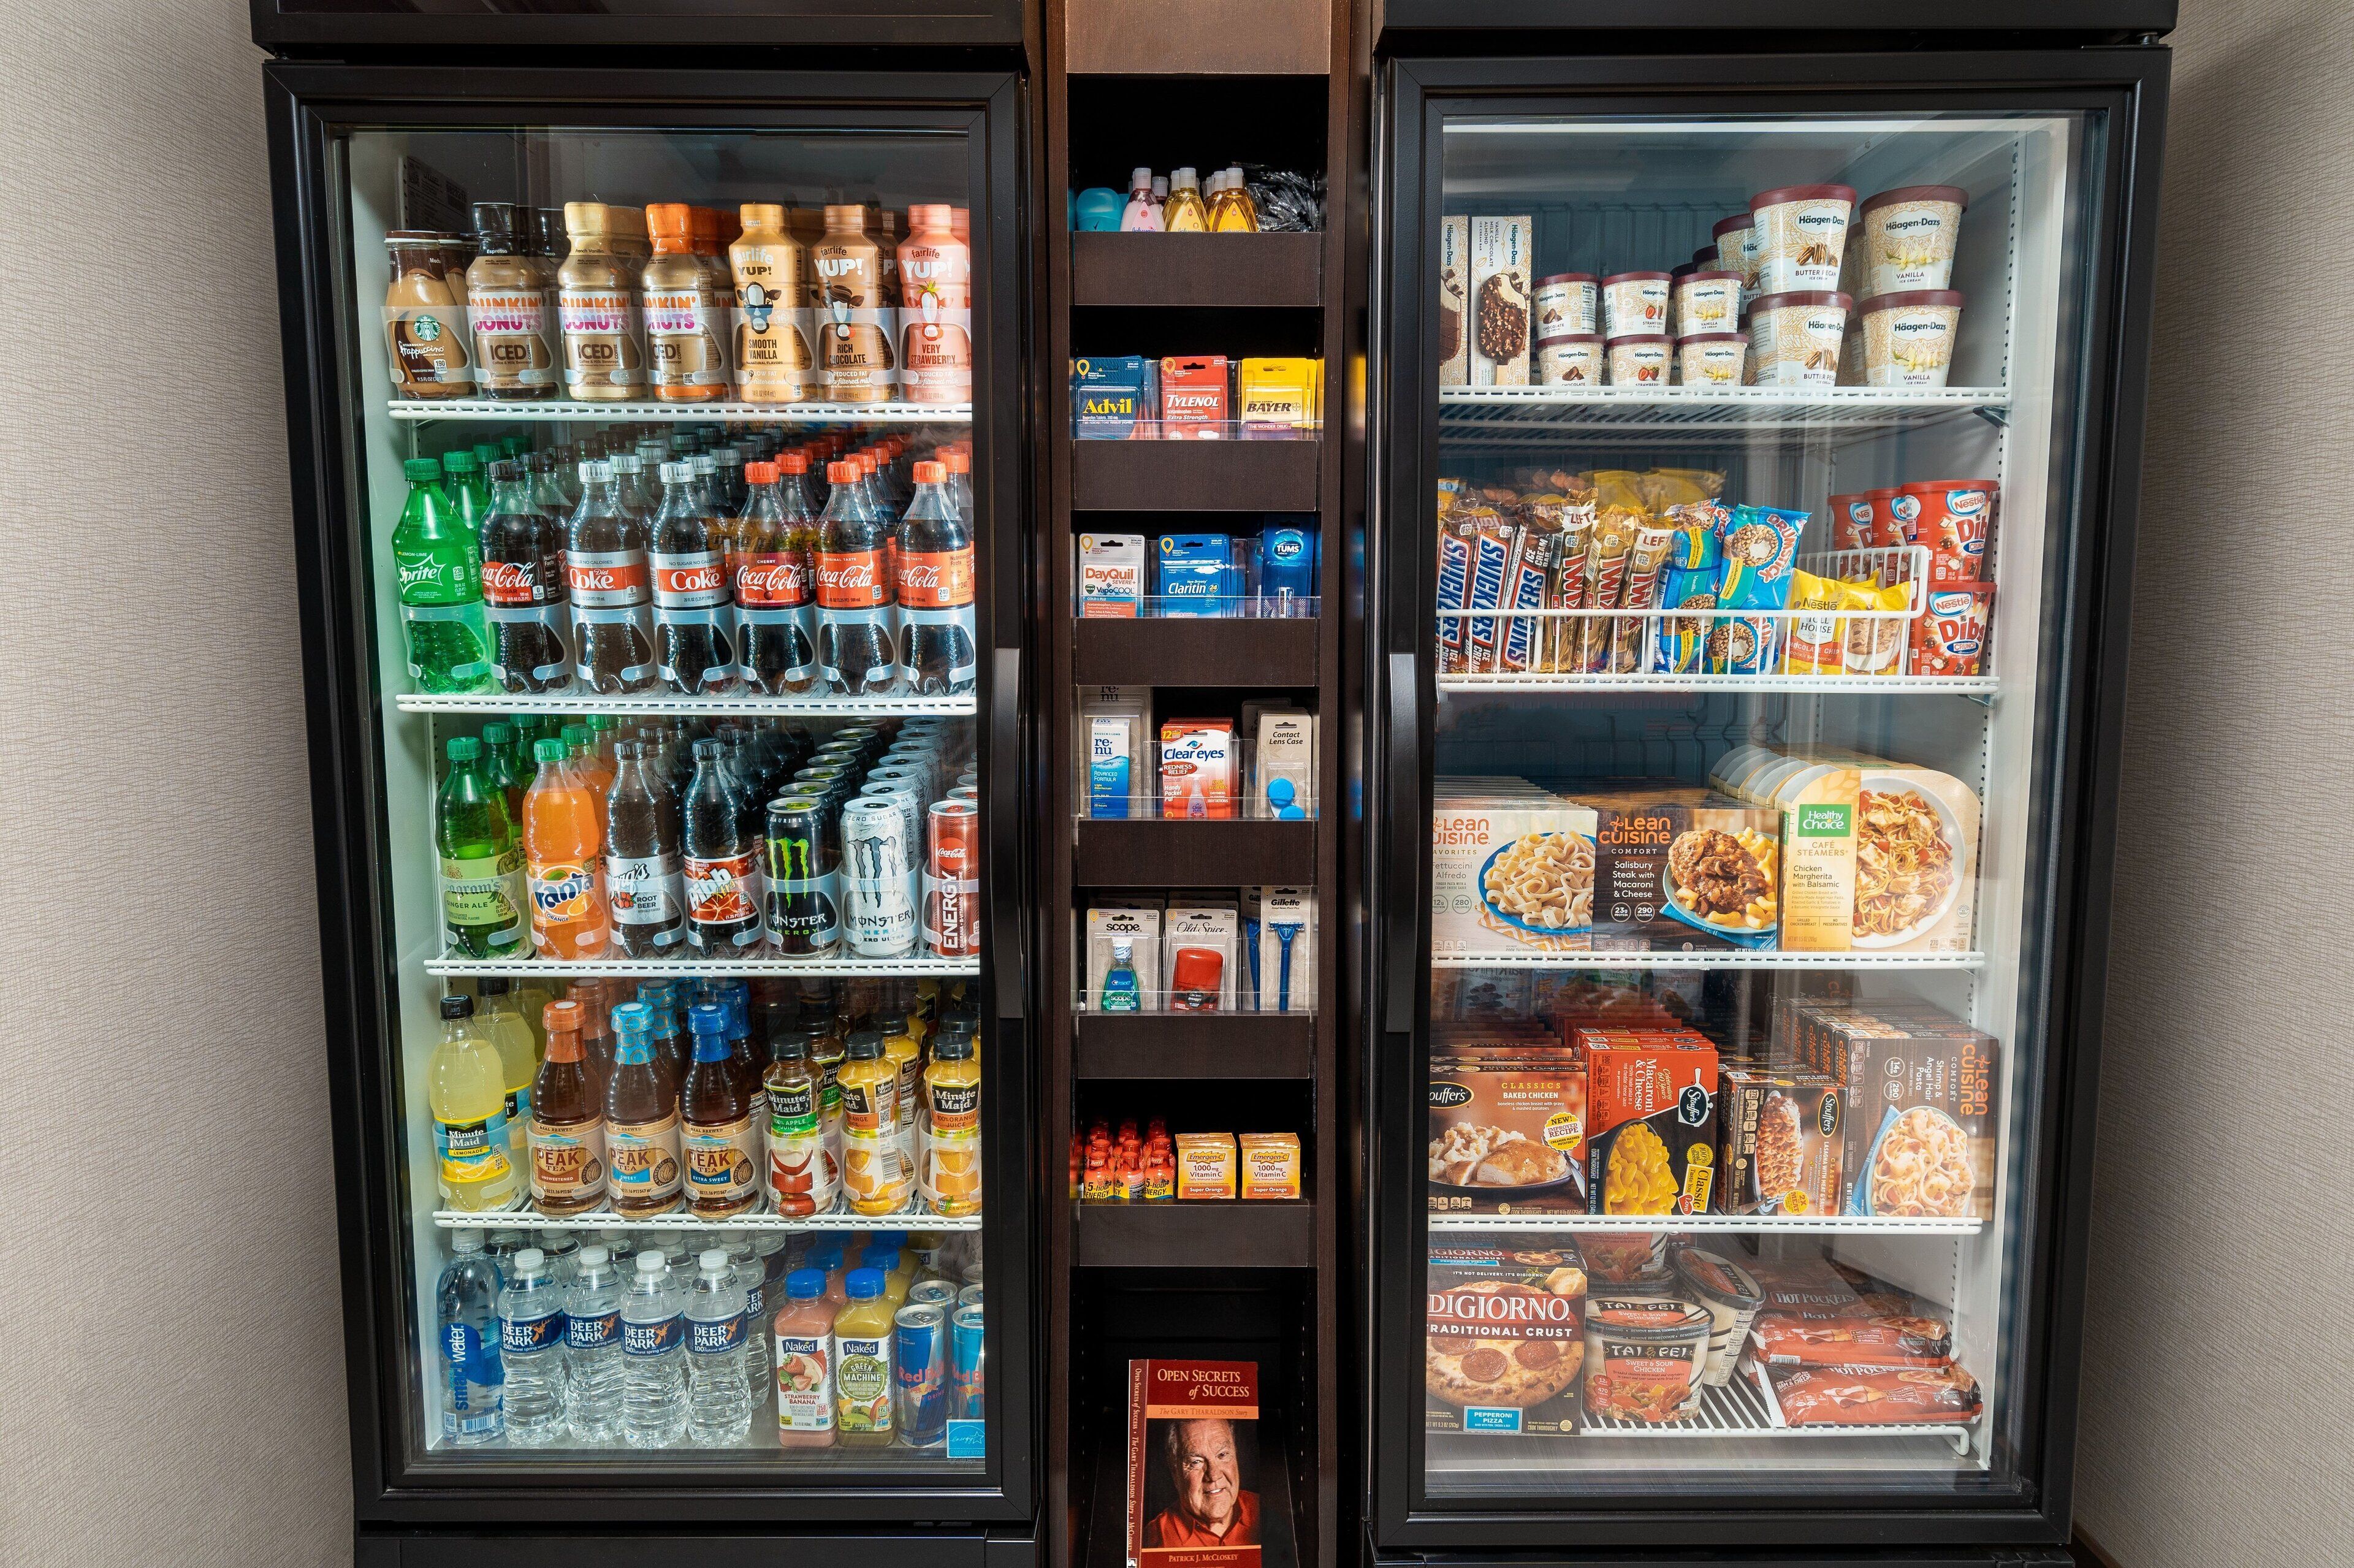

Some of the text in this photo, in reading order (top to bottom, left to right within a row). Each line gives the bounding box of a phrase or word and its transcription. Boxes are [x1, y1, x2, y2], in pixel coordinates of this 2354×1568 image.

[738, 267, 771, 275] YUP!
[814, 259, 864, 276] YUP!
[902, 259, 953, 278] YUP!
[748, 340, 777, 348] SMOOTH
[837, 344, 853, 353] RICH
[922, 344, 940, 354] VERY
[490, 344, 526, 360] ICED
[577, 344, 613, 359] ICED
[749, 350, 777, 359] VANILLA
[829, 354, 866, 364] CHOCOLATE
[911, 355, 955, 364] STRAWBERRY
[1083, 398, 1132, 414] Advil
[1167, 395, 1218, 408] TYLENOL
[1247, 403, 1291, 412] BAYER
[1758, 514, 1799, 584] DRUMSTICK
[399, 566, 437, 584] Sprite
[569, 568, 614, 589] Coke
[671, 571, 720, 591] Coke
[737, 563, 802, 591] Coca-Cola
[817, 564, 875, 588] Coca-Cola
[1086, 568, 1133, 582] DayQuil
[1168, 583, 1205, 594] Claritin
[1937, 596, 1970, 611] Nestlé
[1938, 617, 1984, 643] Dibs
[1165, 749, 1224, 761] Clear eyes
[1808, 811, 1843, 821] Healthy
[1803, 819, 1844, 829] Choice
[1615, 861, 1653, 870] Salisbury
[534, 872, 594, 912] Fanta
[943, 871, 957, 948] ENERGY
[546, 913, 569, 922] ORANGE
[1107, 924, 1140, 933] scope
[1925, 1057, 1934, 1082] Angel
[1935, 1060, 1944, 1090] Shrimp
[1916, 1067, 1924, 1090] Pasta
[1635, 1070, 1645, 1111] Cheese
[1645, 1058, 1657, 1112] Macaroni
[768, 1092, 806, 1103] Minute
[936, 1090, 975, 1100] Minute
[942, 1100, 970, 1109] Maid
[1686, 1089, 1702, 1122] Stouffer's
[1551, 1116, 1572, 1125] NEW!
[1823, 1097, 1835, 1132] Stouffer's
[1548, 1123, 1578, 1132] IMPROVED
[1549, 1127, 1579, 1137] RECIPE
[454, 1138, 479, 1147] Maid
[536, 1151, 580, 1166] PEAK
[611, 1151, 650, 1165] PEAK
[688, 1152, 731, 1167] PEAK
[1694, 1170, 1708, 1208] Classic
[503, 1325, 532, 1336] DEER
[571, 1321, 602, 1331] DEER
[695, 1325, 726, 1336] DEER
[571, 1330, 603, 1342] PARK
[625, 1327, 655, 1339] DEER
[1526, 1328, 1572, 1337] CRUST
[503, 1336, 533, 1346] PARK
[625, 1337, 655, 1349] PARK
[695, 1335, 727, 1346] PARK
[1612, 1345, 1641, 1357] TAI
[851, 1363, 872, 1372] GREEN
[898, 1366, 922, 1382] Red
[1158, 1369, 1240, 1382] OPEN SECRETS
[1189, 1384, 1249, 1399] of SUCCESS
